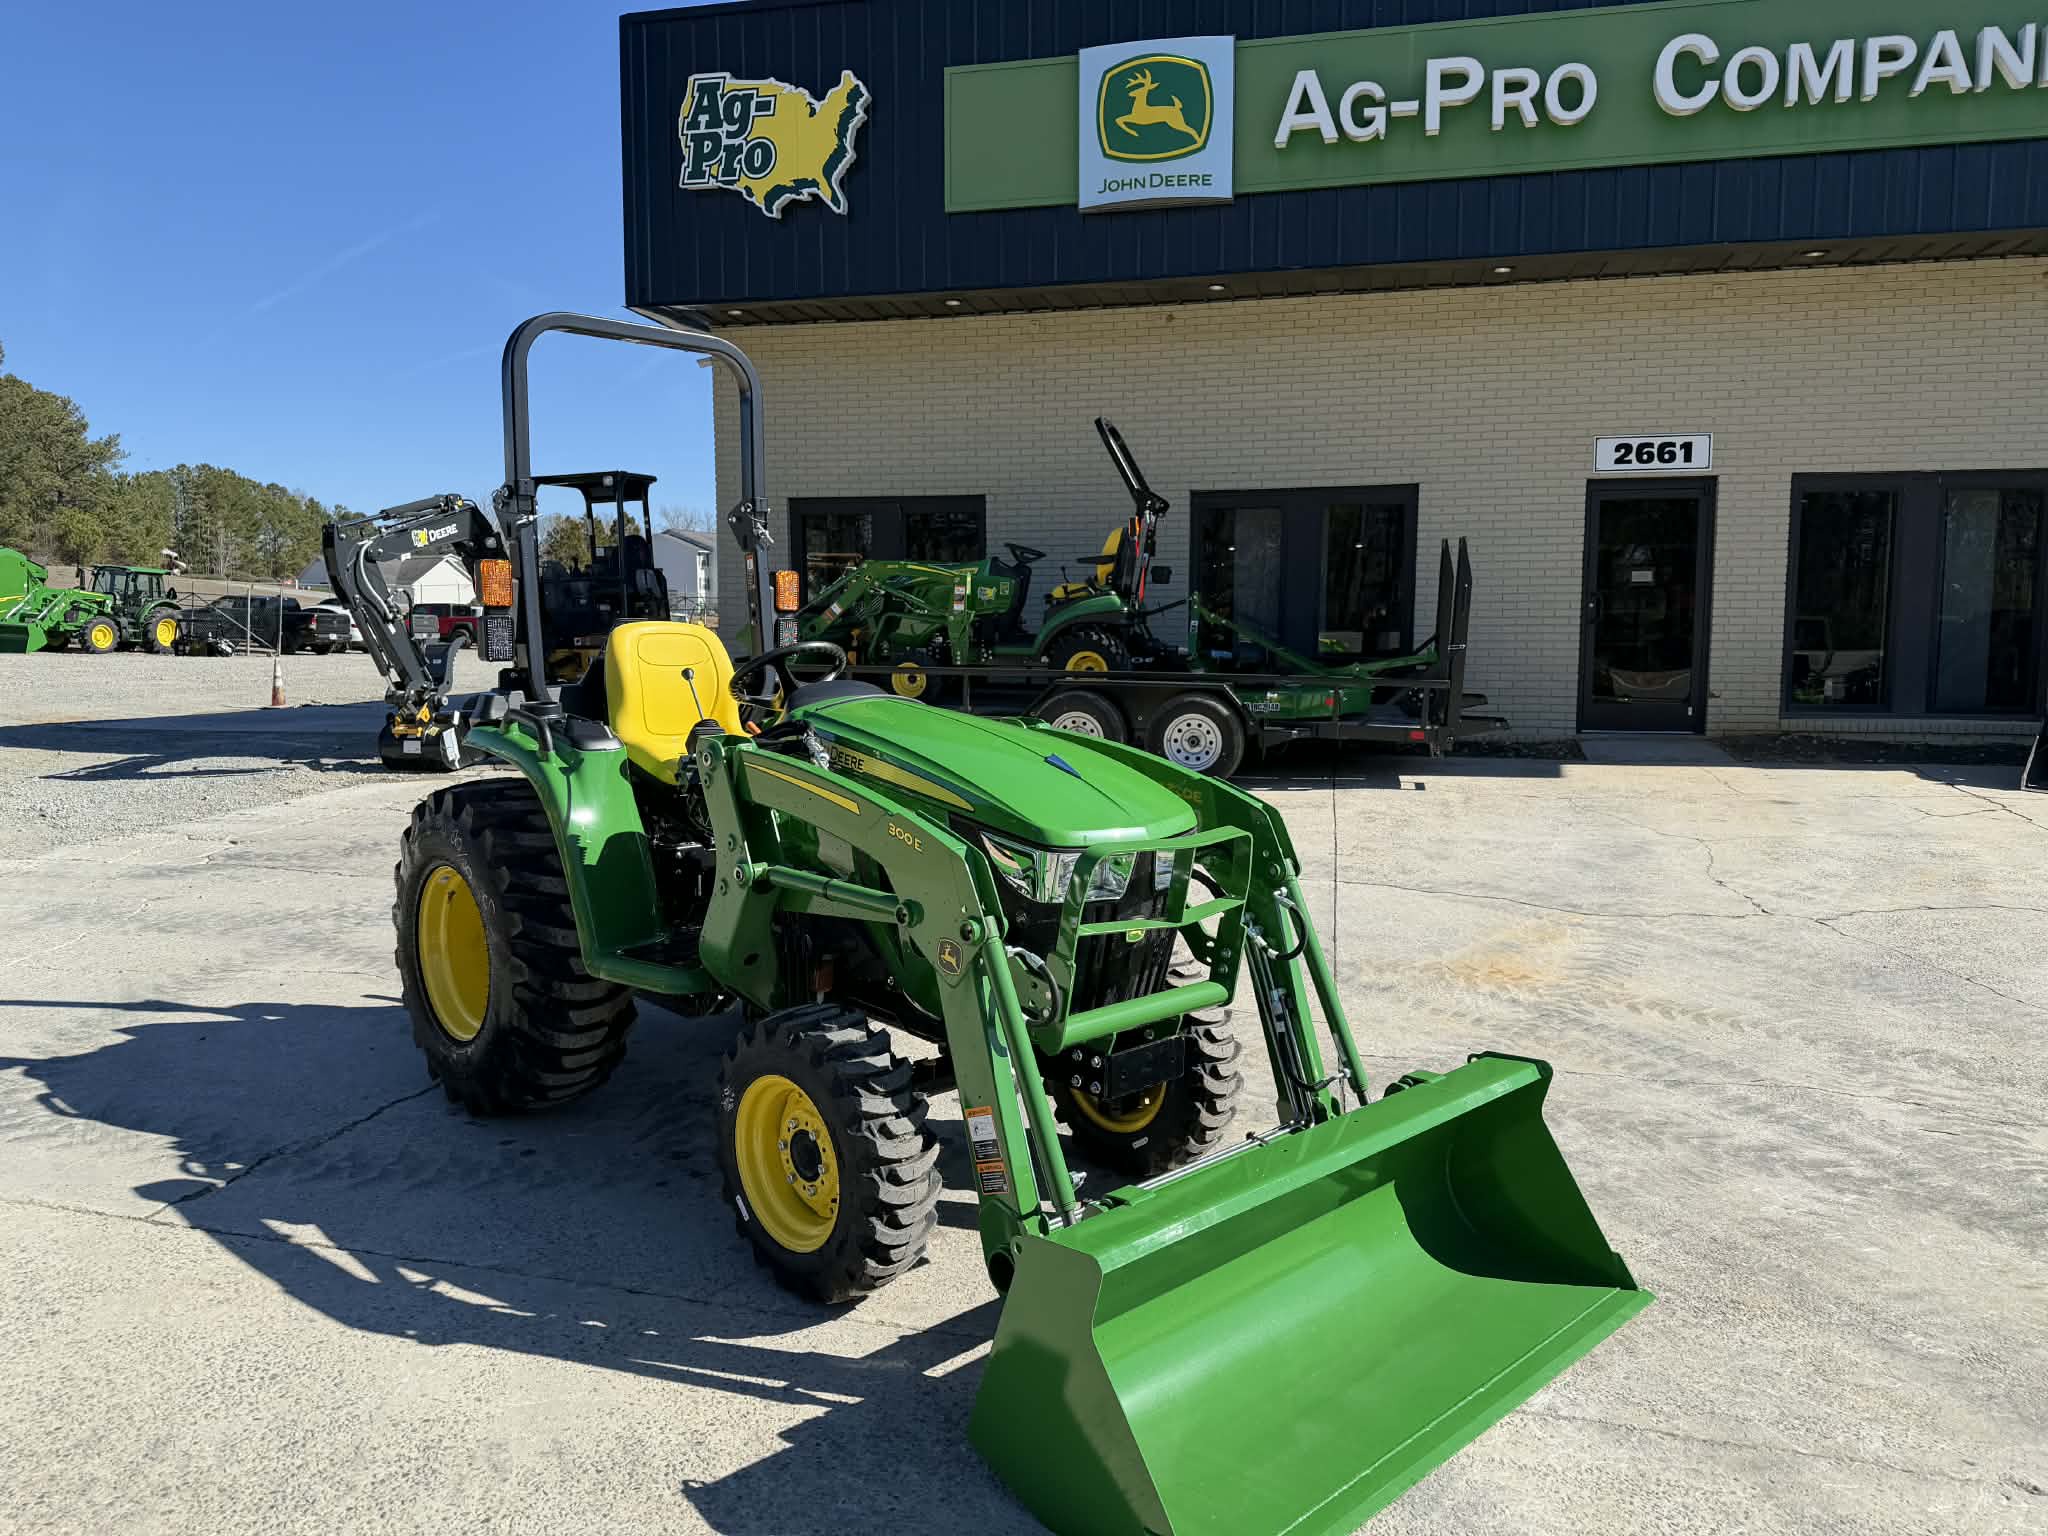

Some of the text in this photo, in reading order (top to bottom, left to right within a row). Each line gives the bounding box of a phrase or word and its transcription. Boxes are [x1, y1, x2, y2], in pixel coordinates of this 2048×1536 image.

[683, 76, 776, 142] Ag-
[683, 129, 777, 184] Pro
[1097, 173, 1213, 194] JOHN DEERE
[1613, 441, 1693, 465] 2661
[428, 523, 459, 543] DEERE
[831, 745, 865, 771] DEERE
